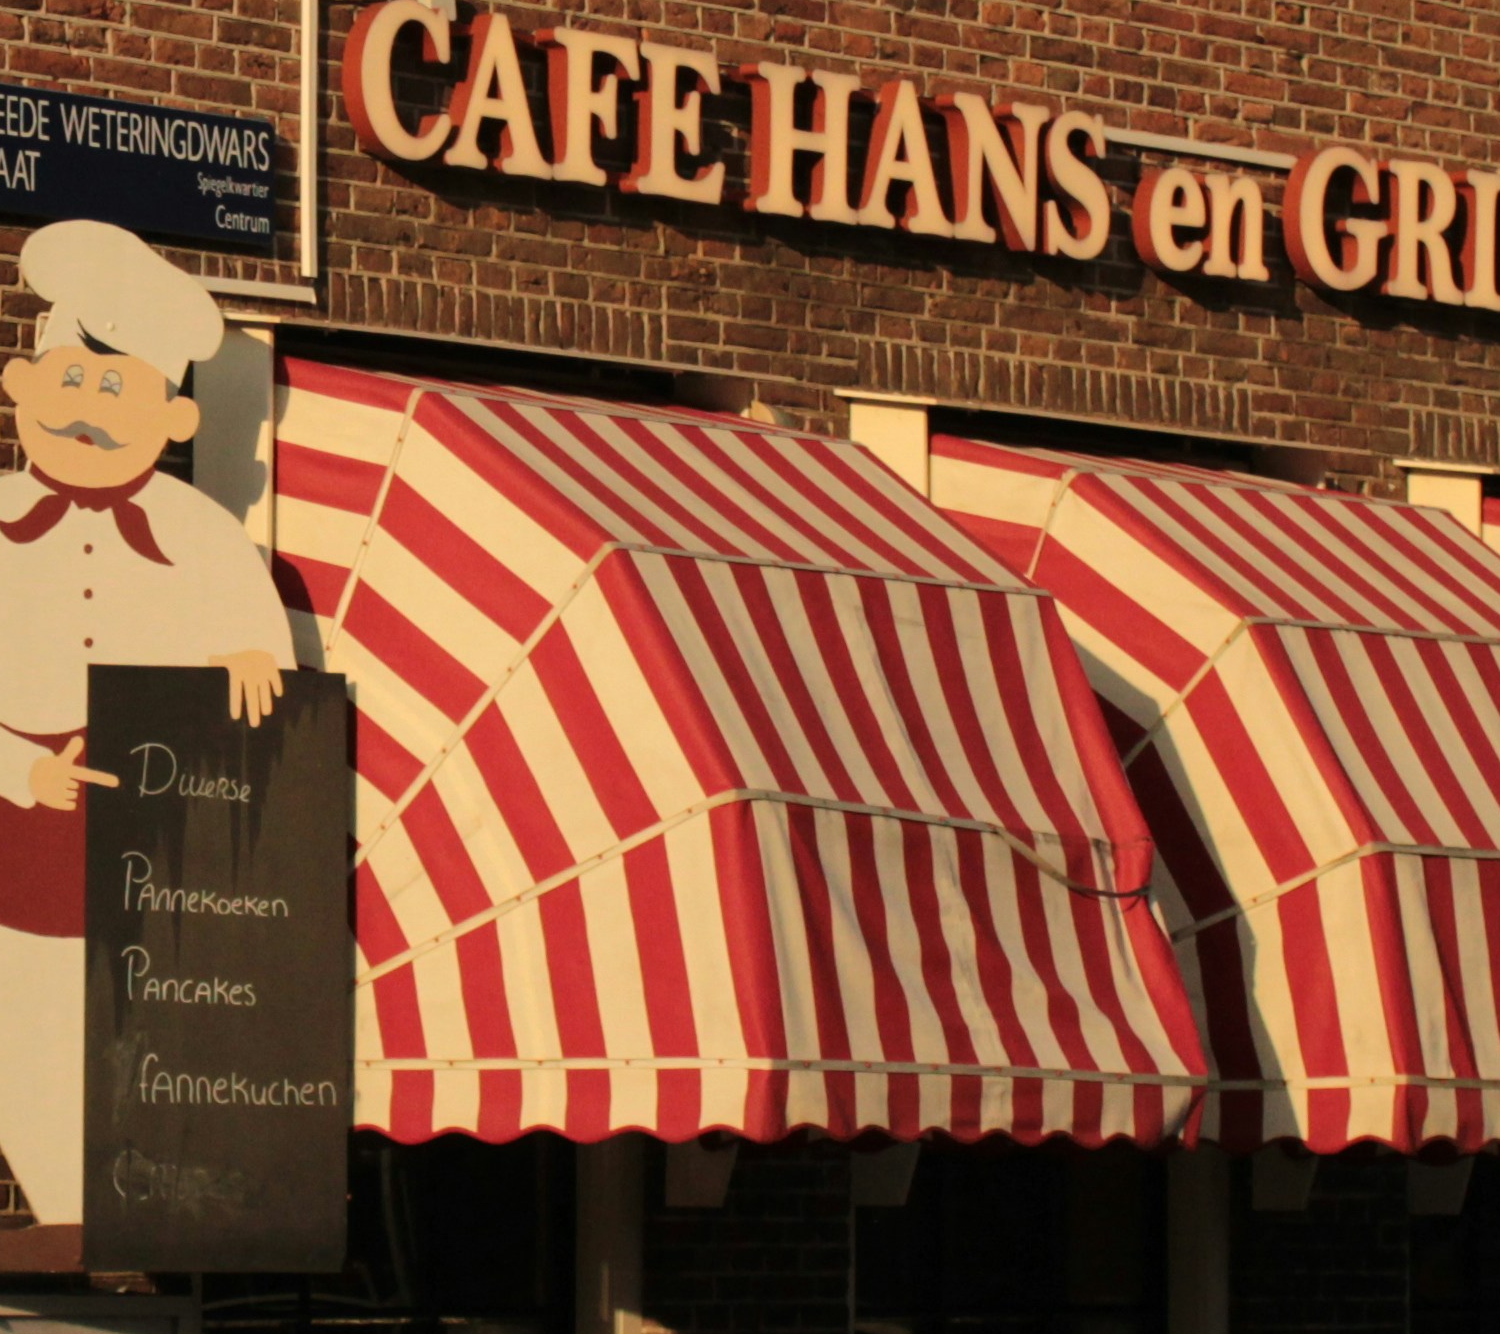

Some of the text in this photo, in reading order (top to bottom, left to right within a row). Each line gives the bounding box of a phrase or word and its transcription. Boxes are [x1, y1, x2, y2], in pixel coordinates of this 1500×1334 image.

[60, 102, 270, 172] WETERINGDWARS
[197, 172, 270, 200] Spiegelkwartier
[742, 63, 1110, 260] HANS
[1132, 167, 1270, 281] en
[215, 205, 270, 234] Centrum
